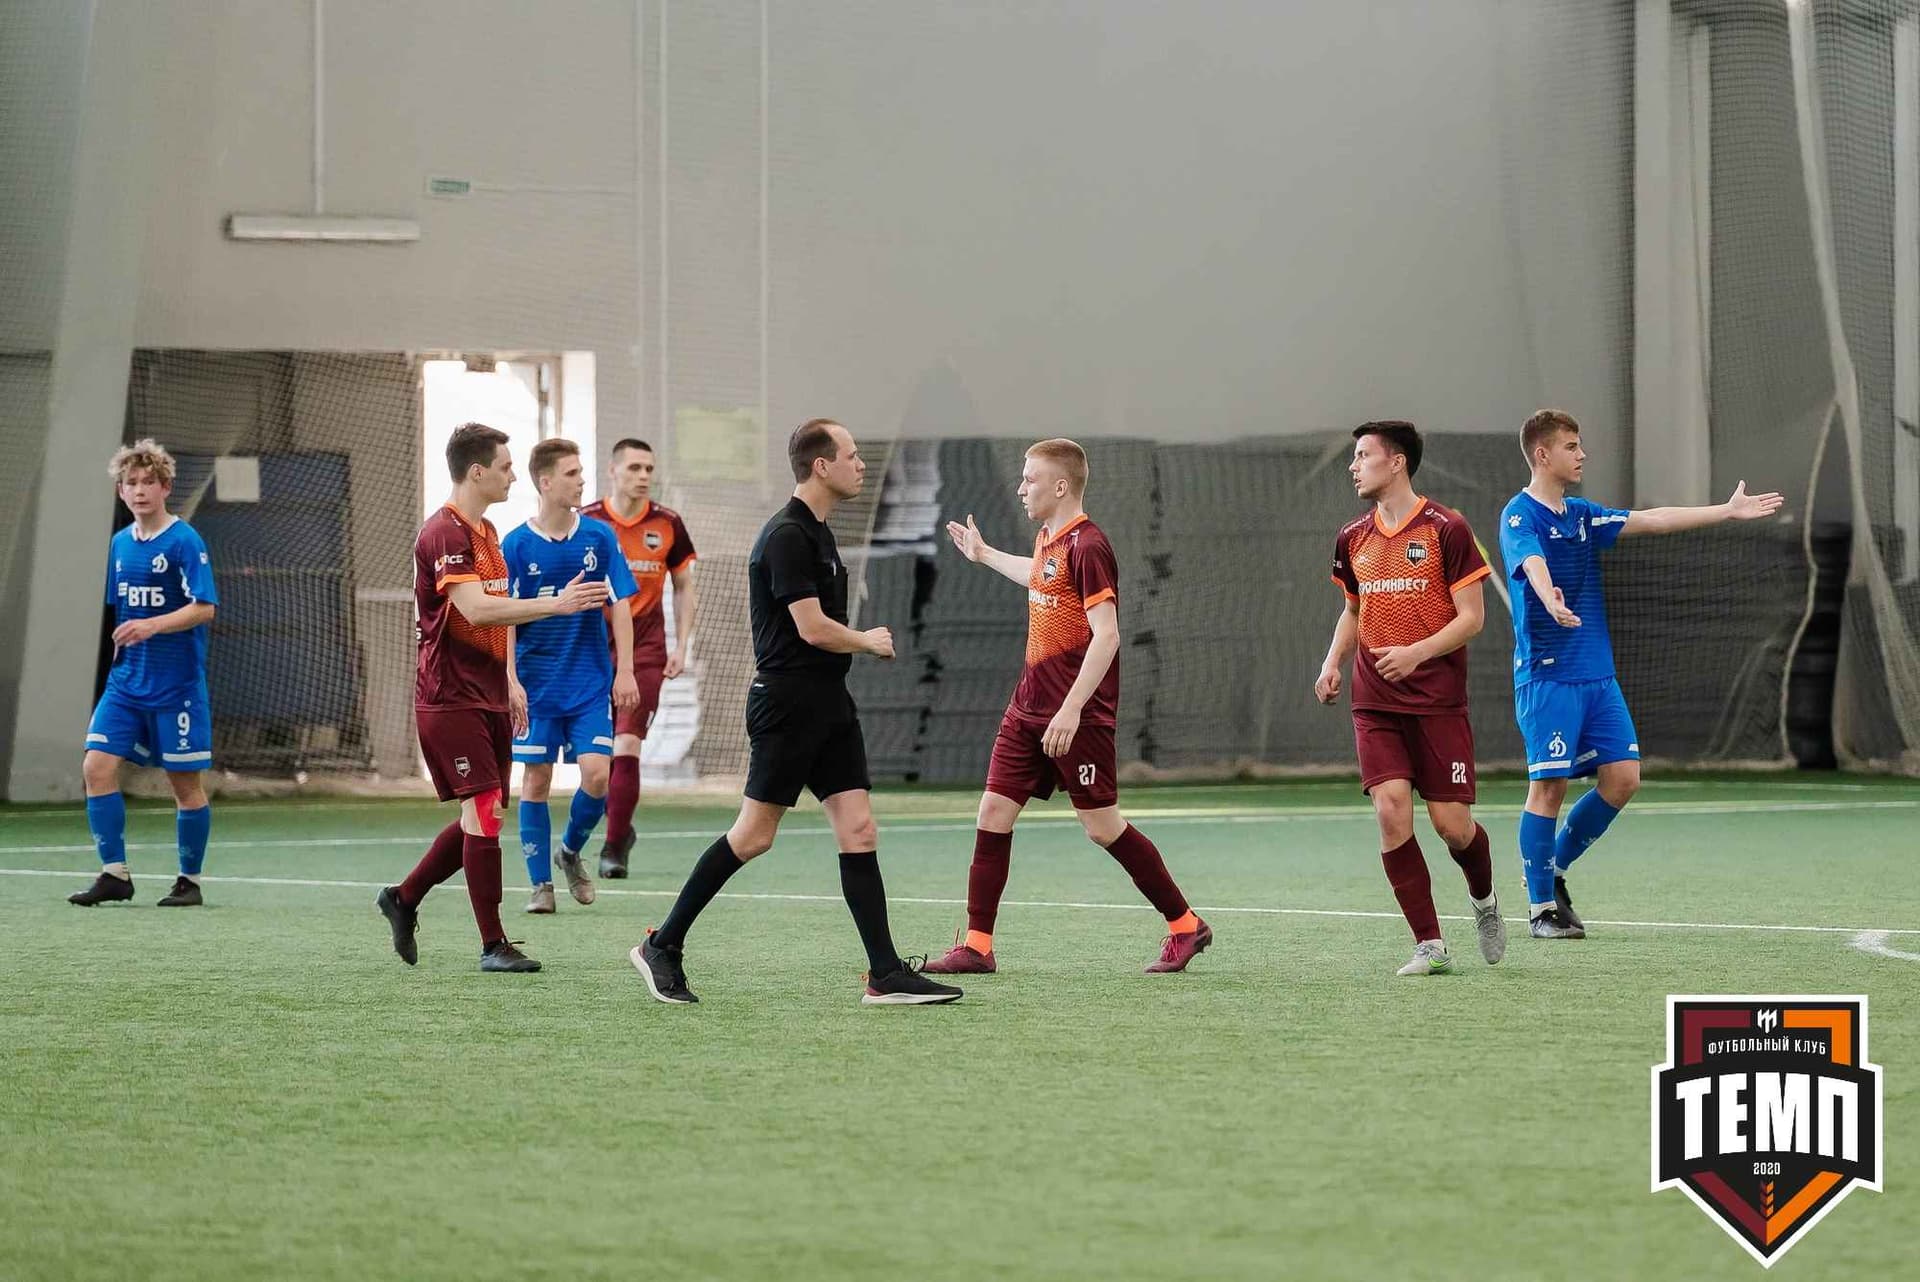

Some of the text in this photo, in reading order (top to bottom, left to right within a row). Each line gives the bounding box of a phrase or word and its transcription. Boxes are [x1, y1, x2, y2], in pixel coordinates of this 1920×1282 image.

[128, 586, 165, 607] ВТБ
[177, 711, 190, 736] 9
[1078, 764, 1096, 786] 27
[1452, 761, 1467, 784] 22
